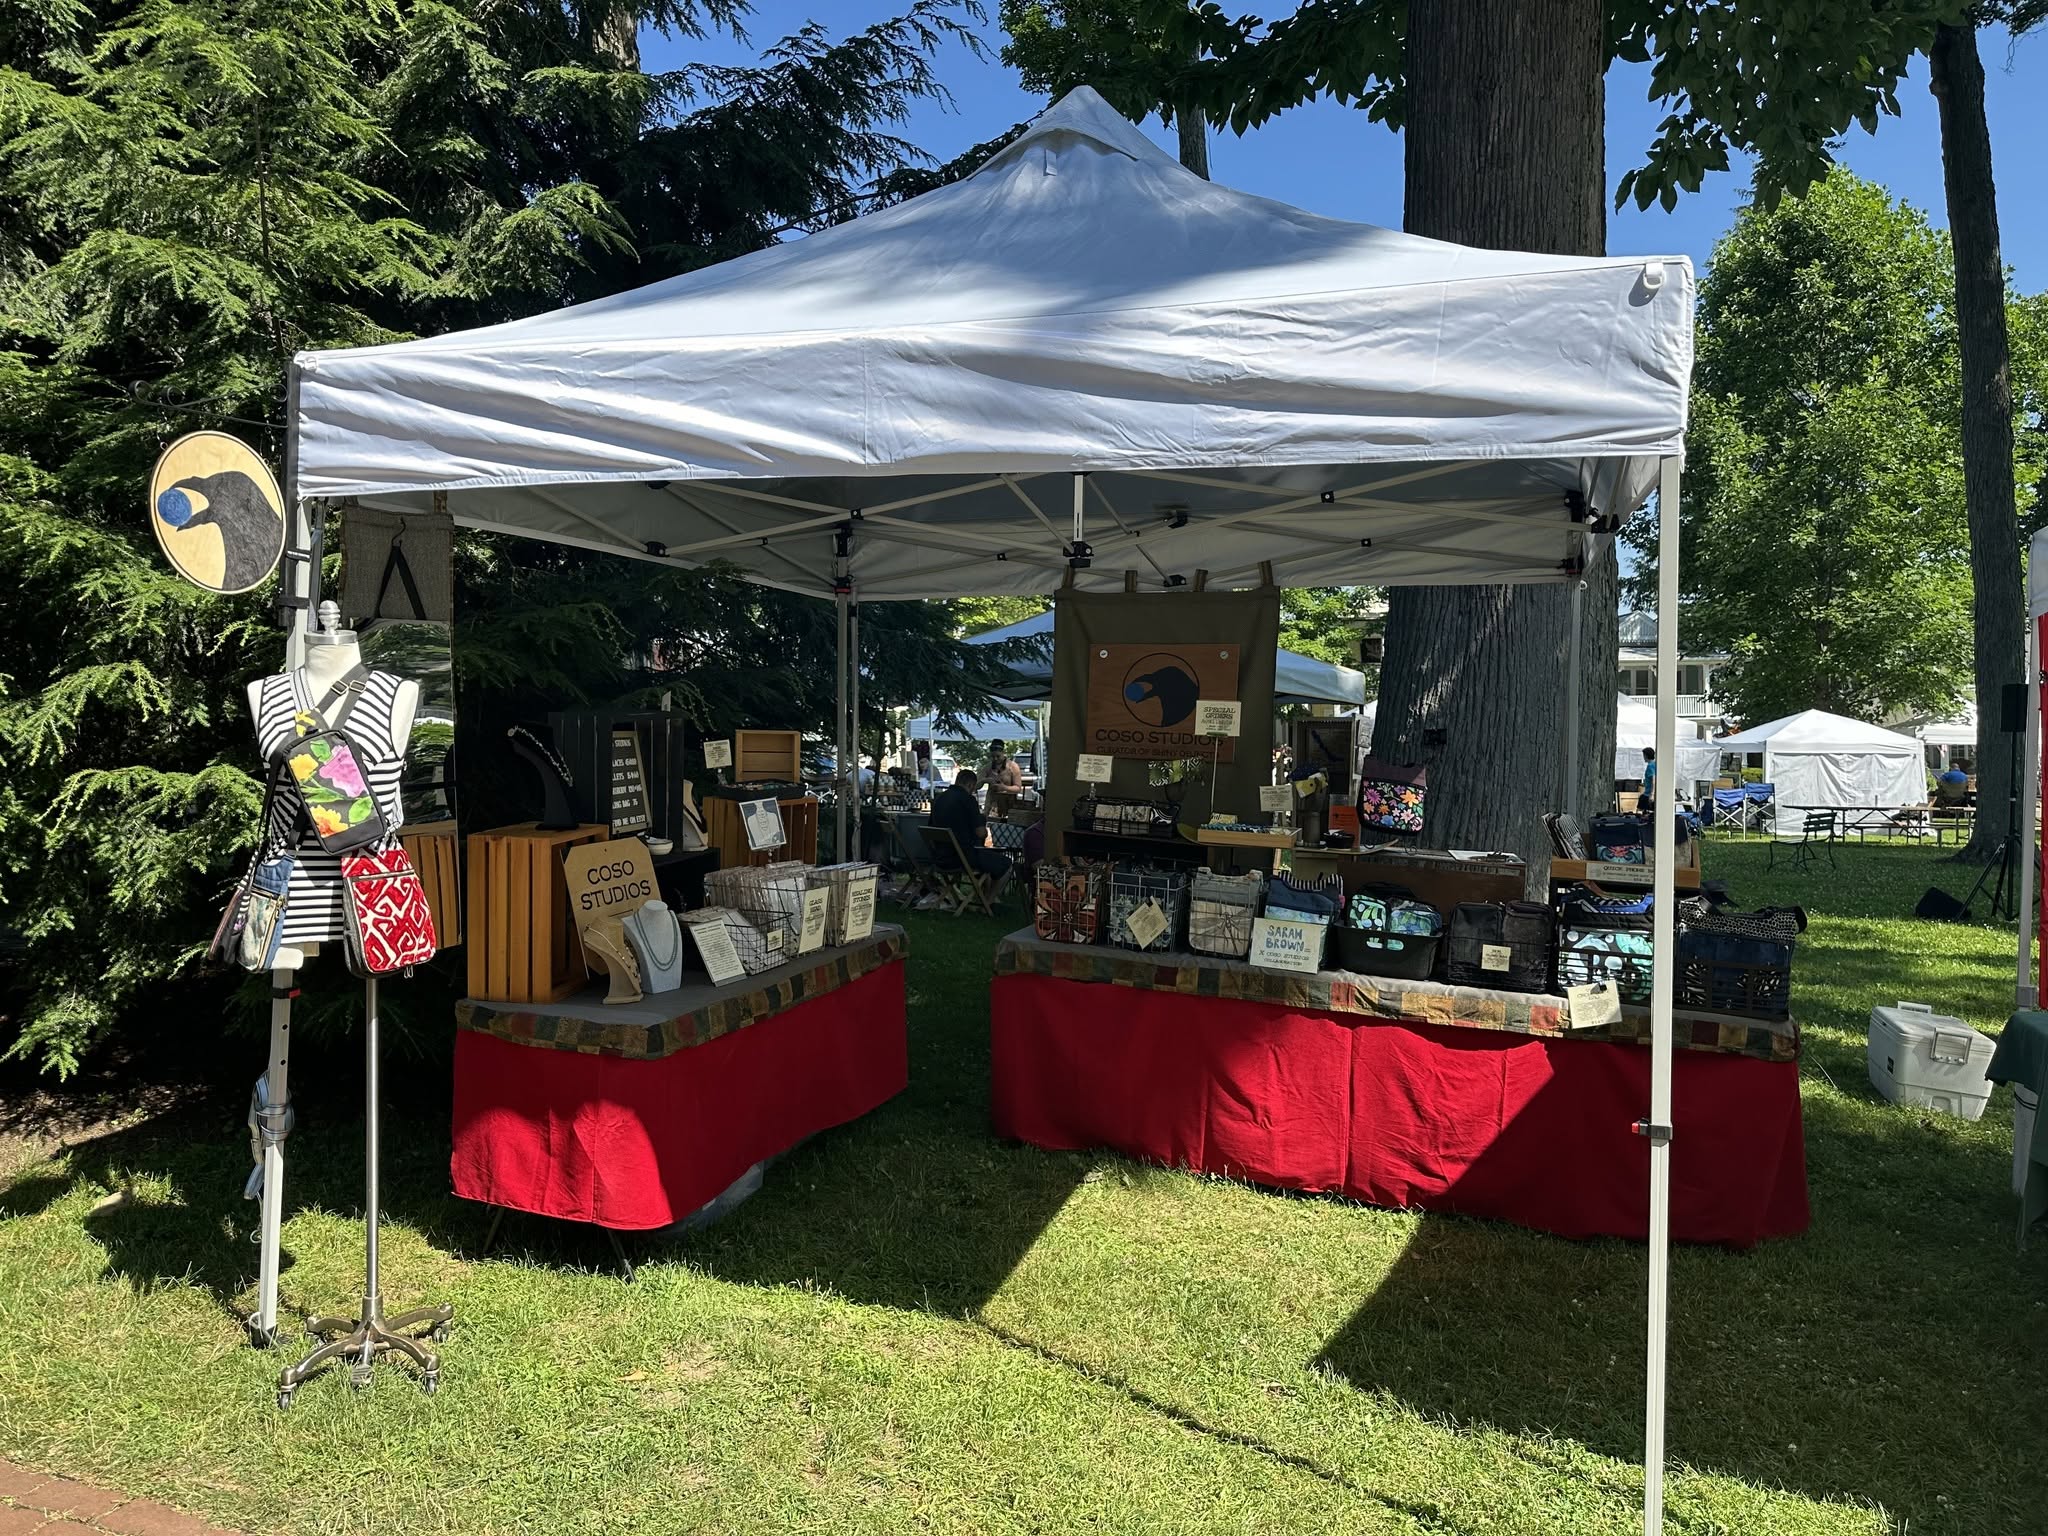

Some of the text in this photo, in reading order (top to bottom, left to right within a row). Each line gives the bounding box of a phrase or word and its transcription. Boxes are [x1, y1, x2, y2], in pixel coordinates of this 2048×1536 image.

[1203, 706, 1236, 714] SPECIAL
[1095, 729, 1145, 743] COSO
[587, 860, 635, 885] COSO
[580, 880, 651, 910] STUDIOS
[1267, 925, 1303, 940] SARAH
[1265, 937, 1305, 952] BROWN
